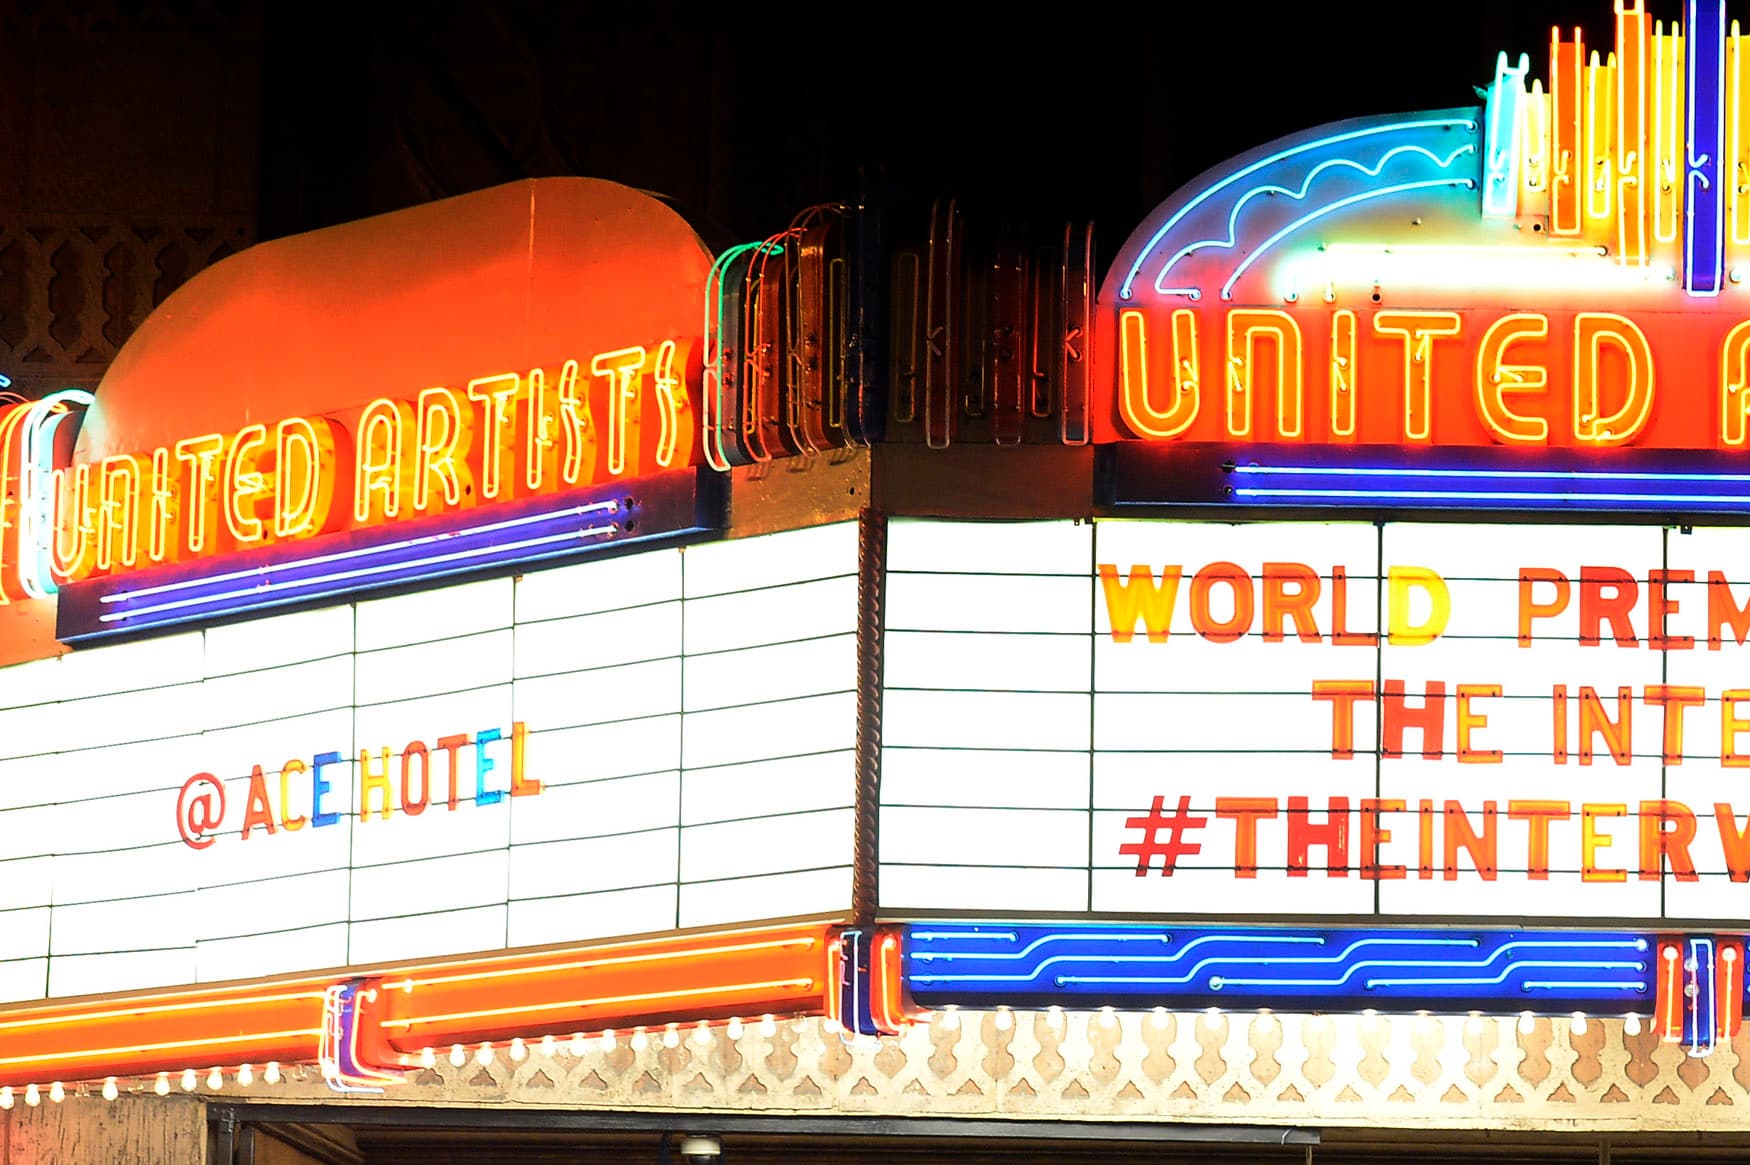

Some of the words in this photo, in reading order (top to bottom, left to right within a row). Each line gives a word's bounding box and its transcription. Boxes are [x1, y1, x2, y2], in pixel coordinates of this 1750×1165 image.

[1118, 308, 1656, 443] UNITED
[51, 416, 332, 579] UNITED
[353, 338, 694, 523] ARTISTS
[1097, 562, 1451, 647] WORLD
[175, 771, 226, 850] @
[241, 750, 343, 841] ACE
[359, 721, 543, 825] HOTEL
[1311, 679, 1503, 764] THE
